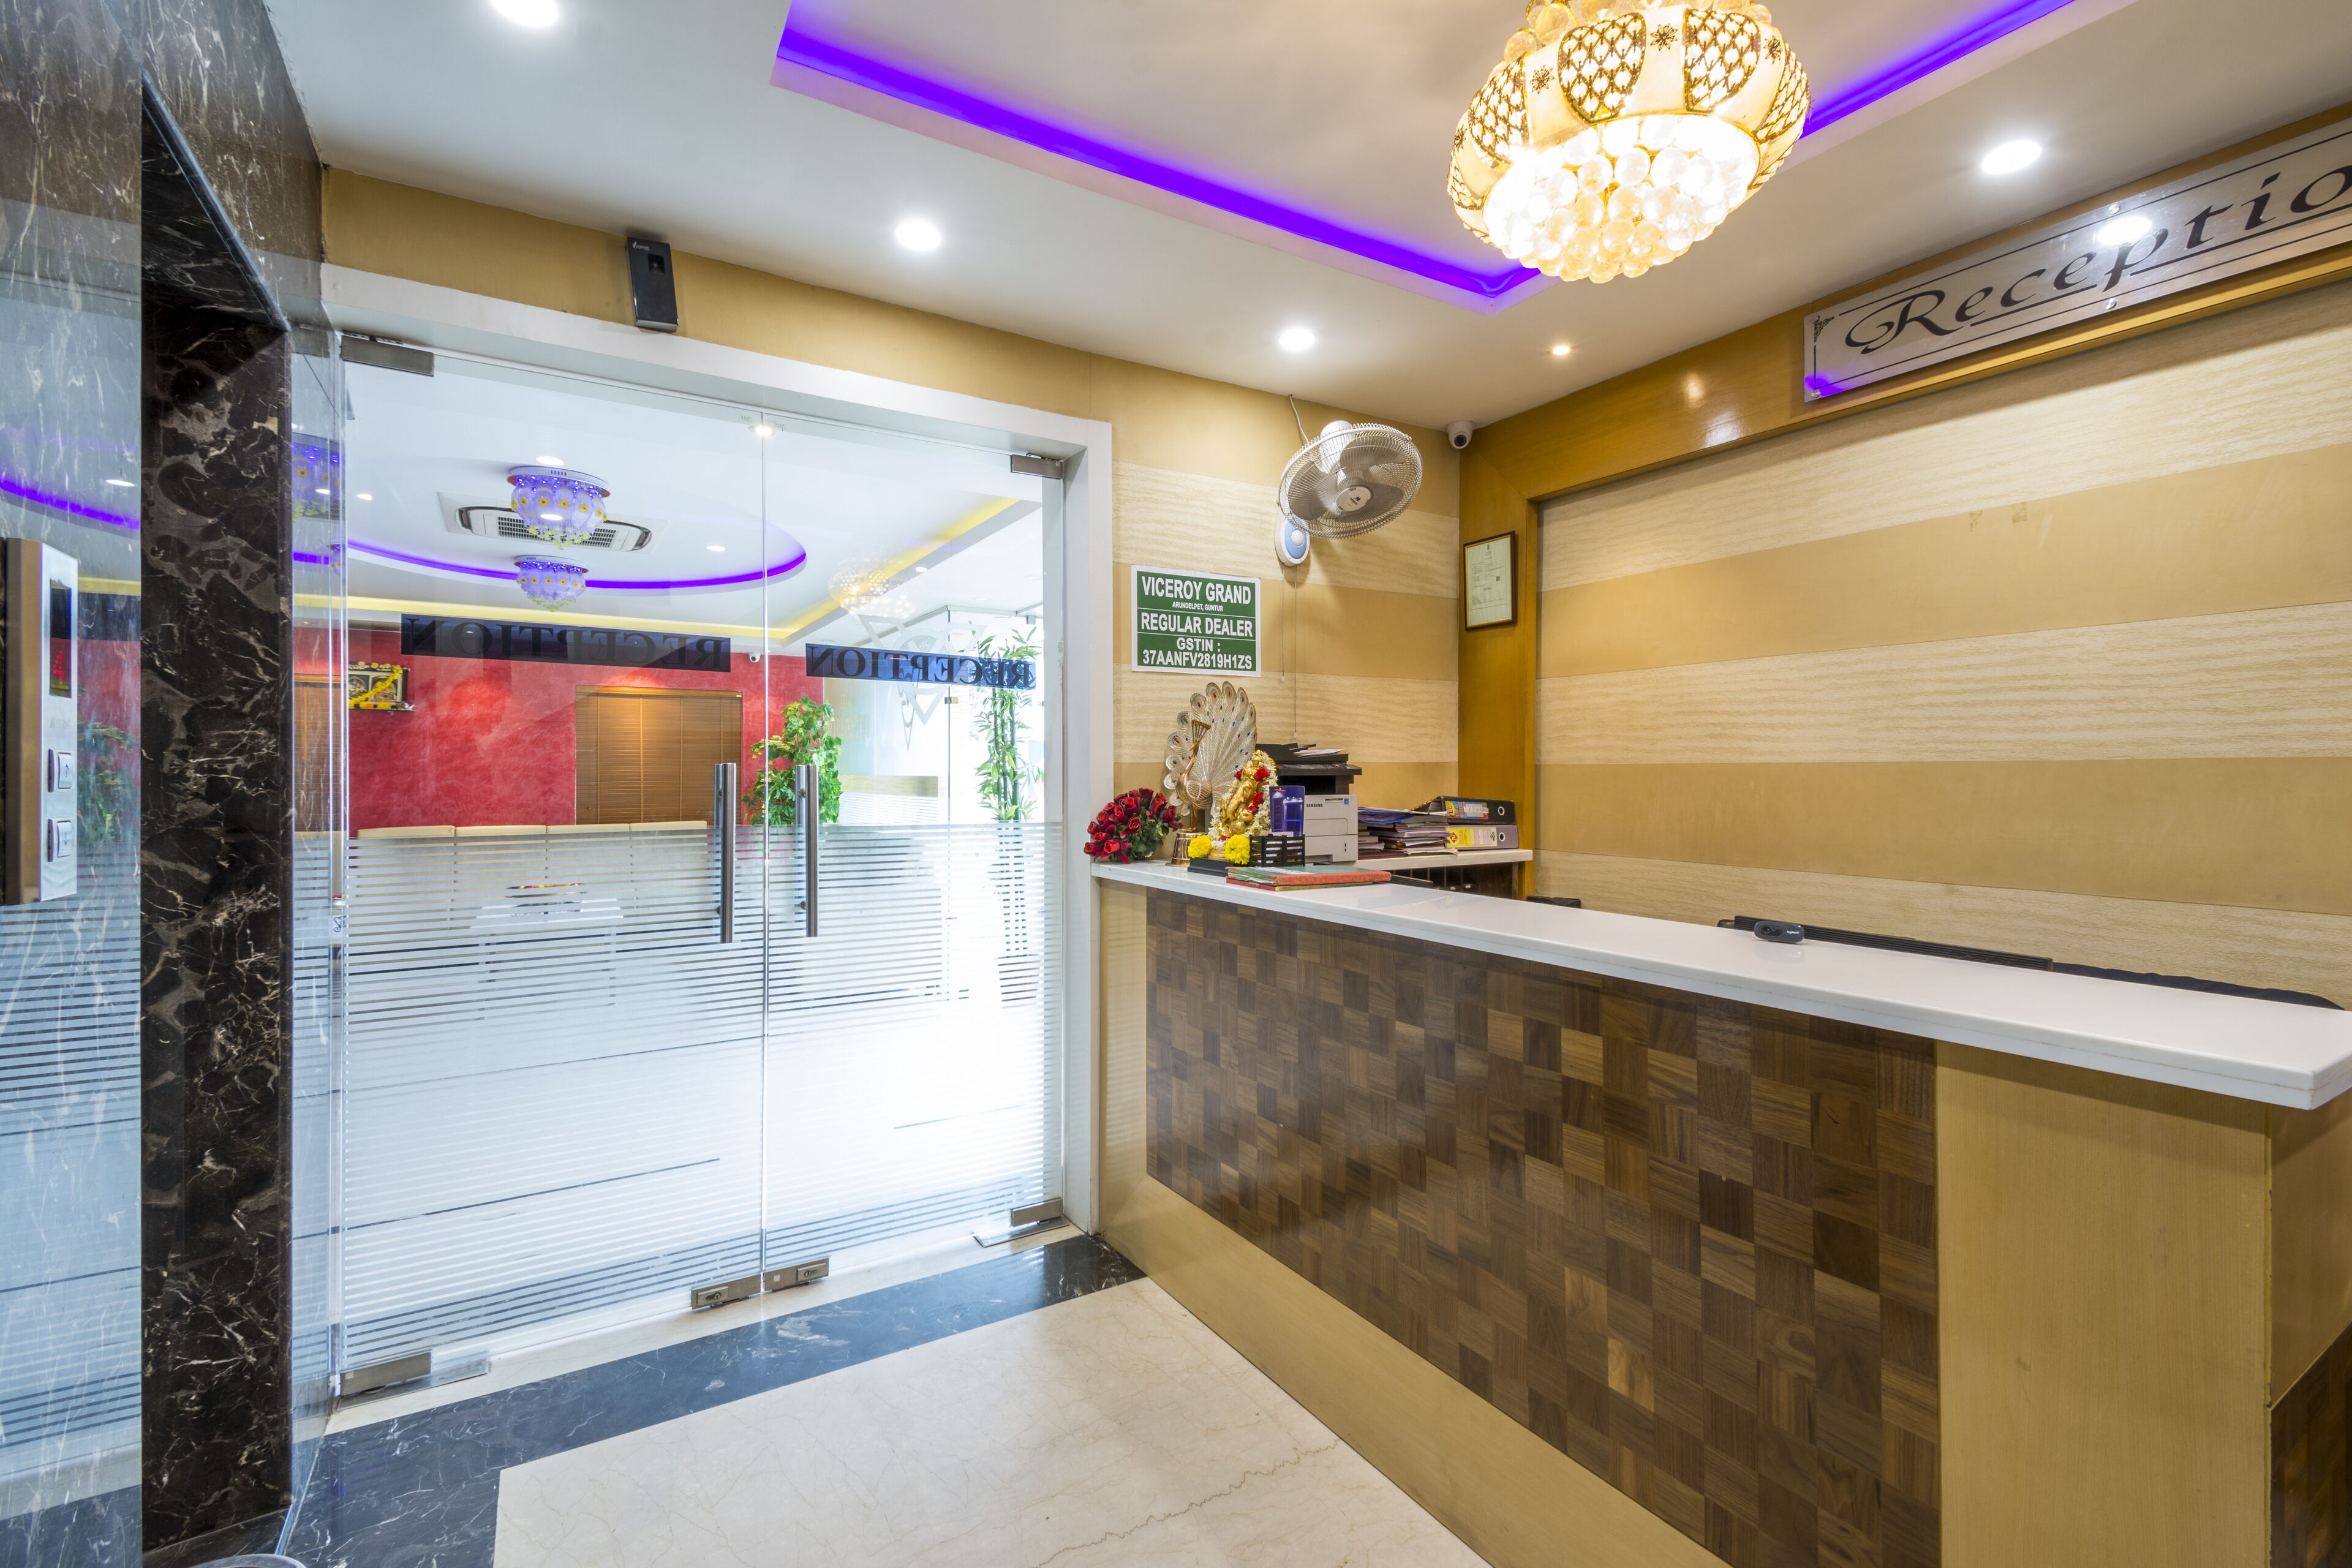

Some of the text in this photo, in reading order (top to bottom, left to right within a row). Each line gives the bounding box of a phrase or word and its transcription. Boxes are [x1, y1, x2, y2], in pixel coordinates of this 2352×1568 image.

[1142, 576, 1251, 604] VICEROY GRAND
[1172, 601, 1204, 611] ARUNDELPET,
[1141, 612, 1253, 637] REGULAR DEALER
[1176, 637, 1213, 651] GSTIN
